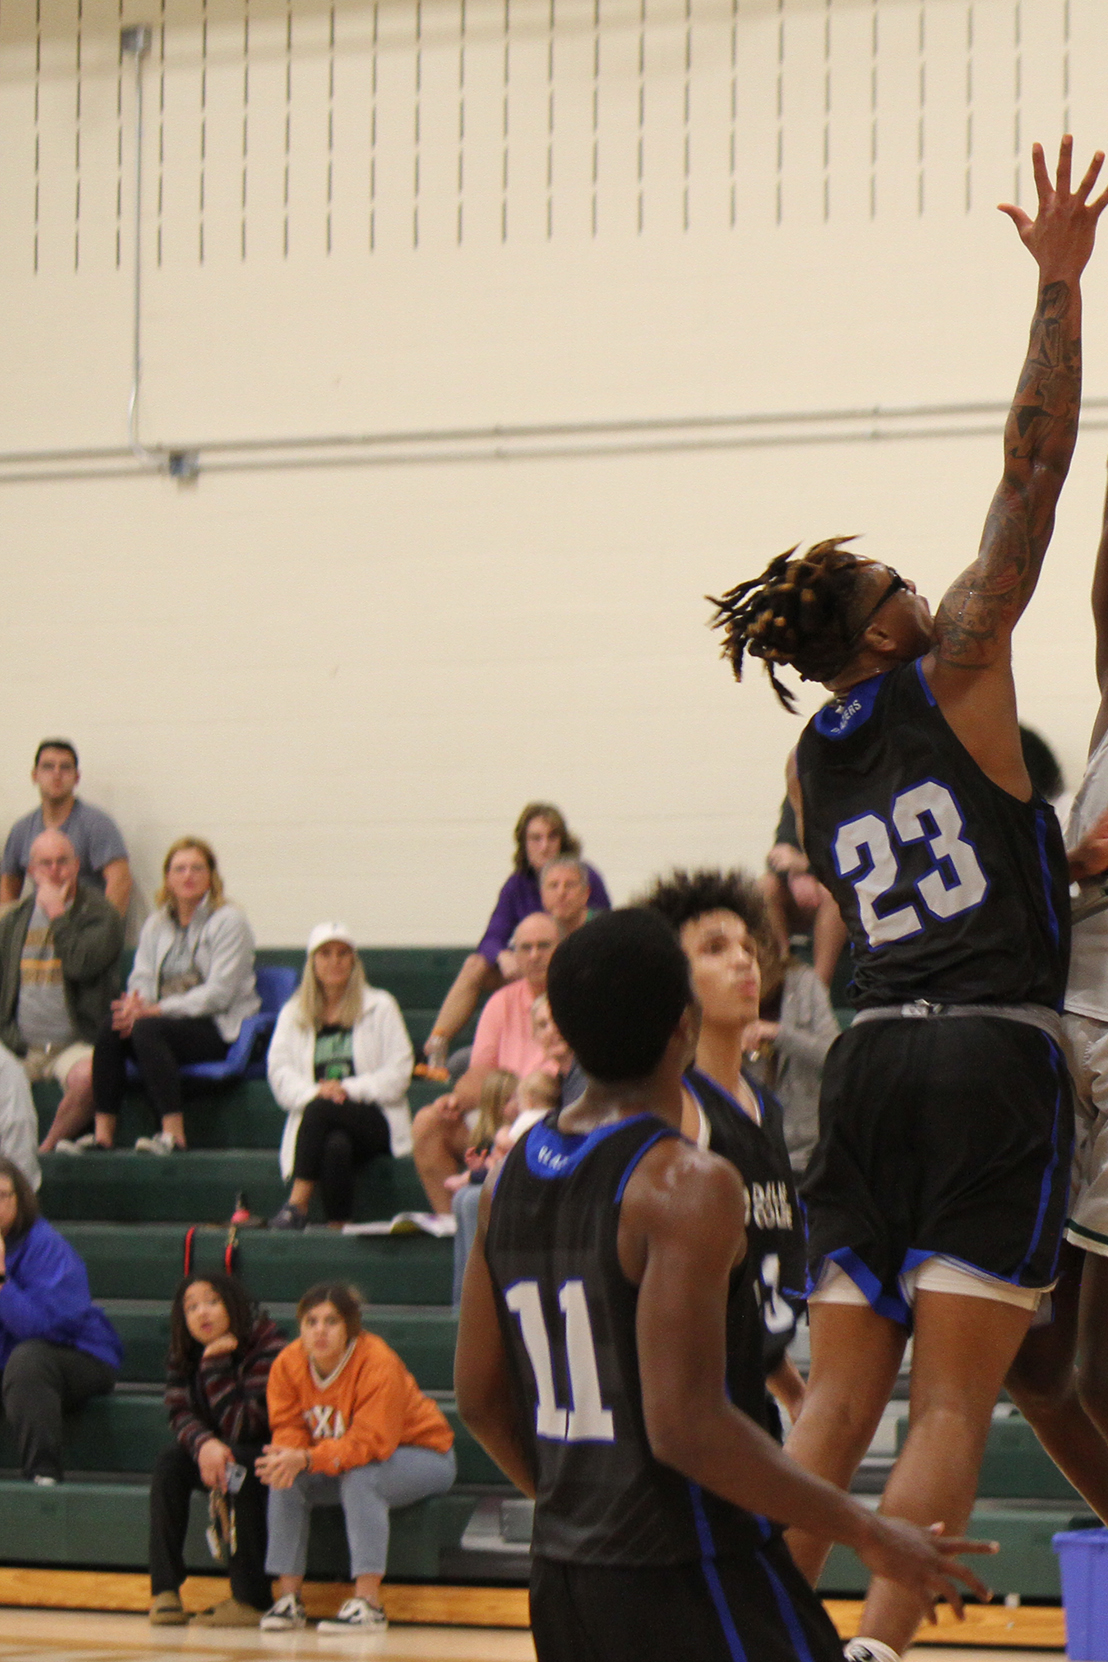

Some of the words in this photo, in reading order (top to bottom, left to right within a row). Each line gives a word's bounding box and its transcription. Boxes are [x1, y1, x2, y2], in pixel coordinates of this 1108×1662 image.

[832, 778, 989, 949] 23
[504, 1277, 615, 1442] 11
[753, 1252, 795, 1334] 3
